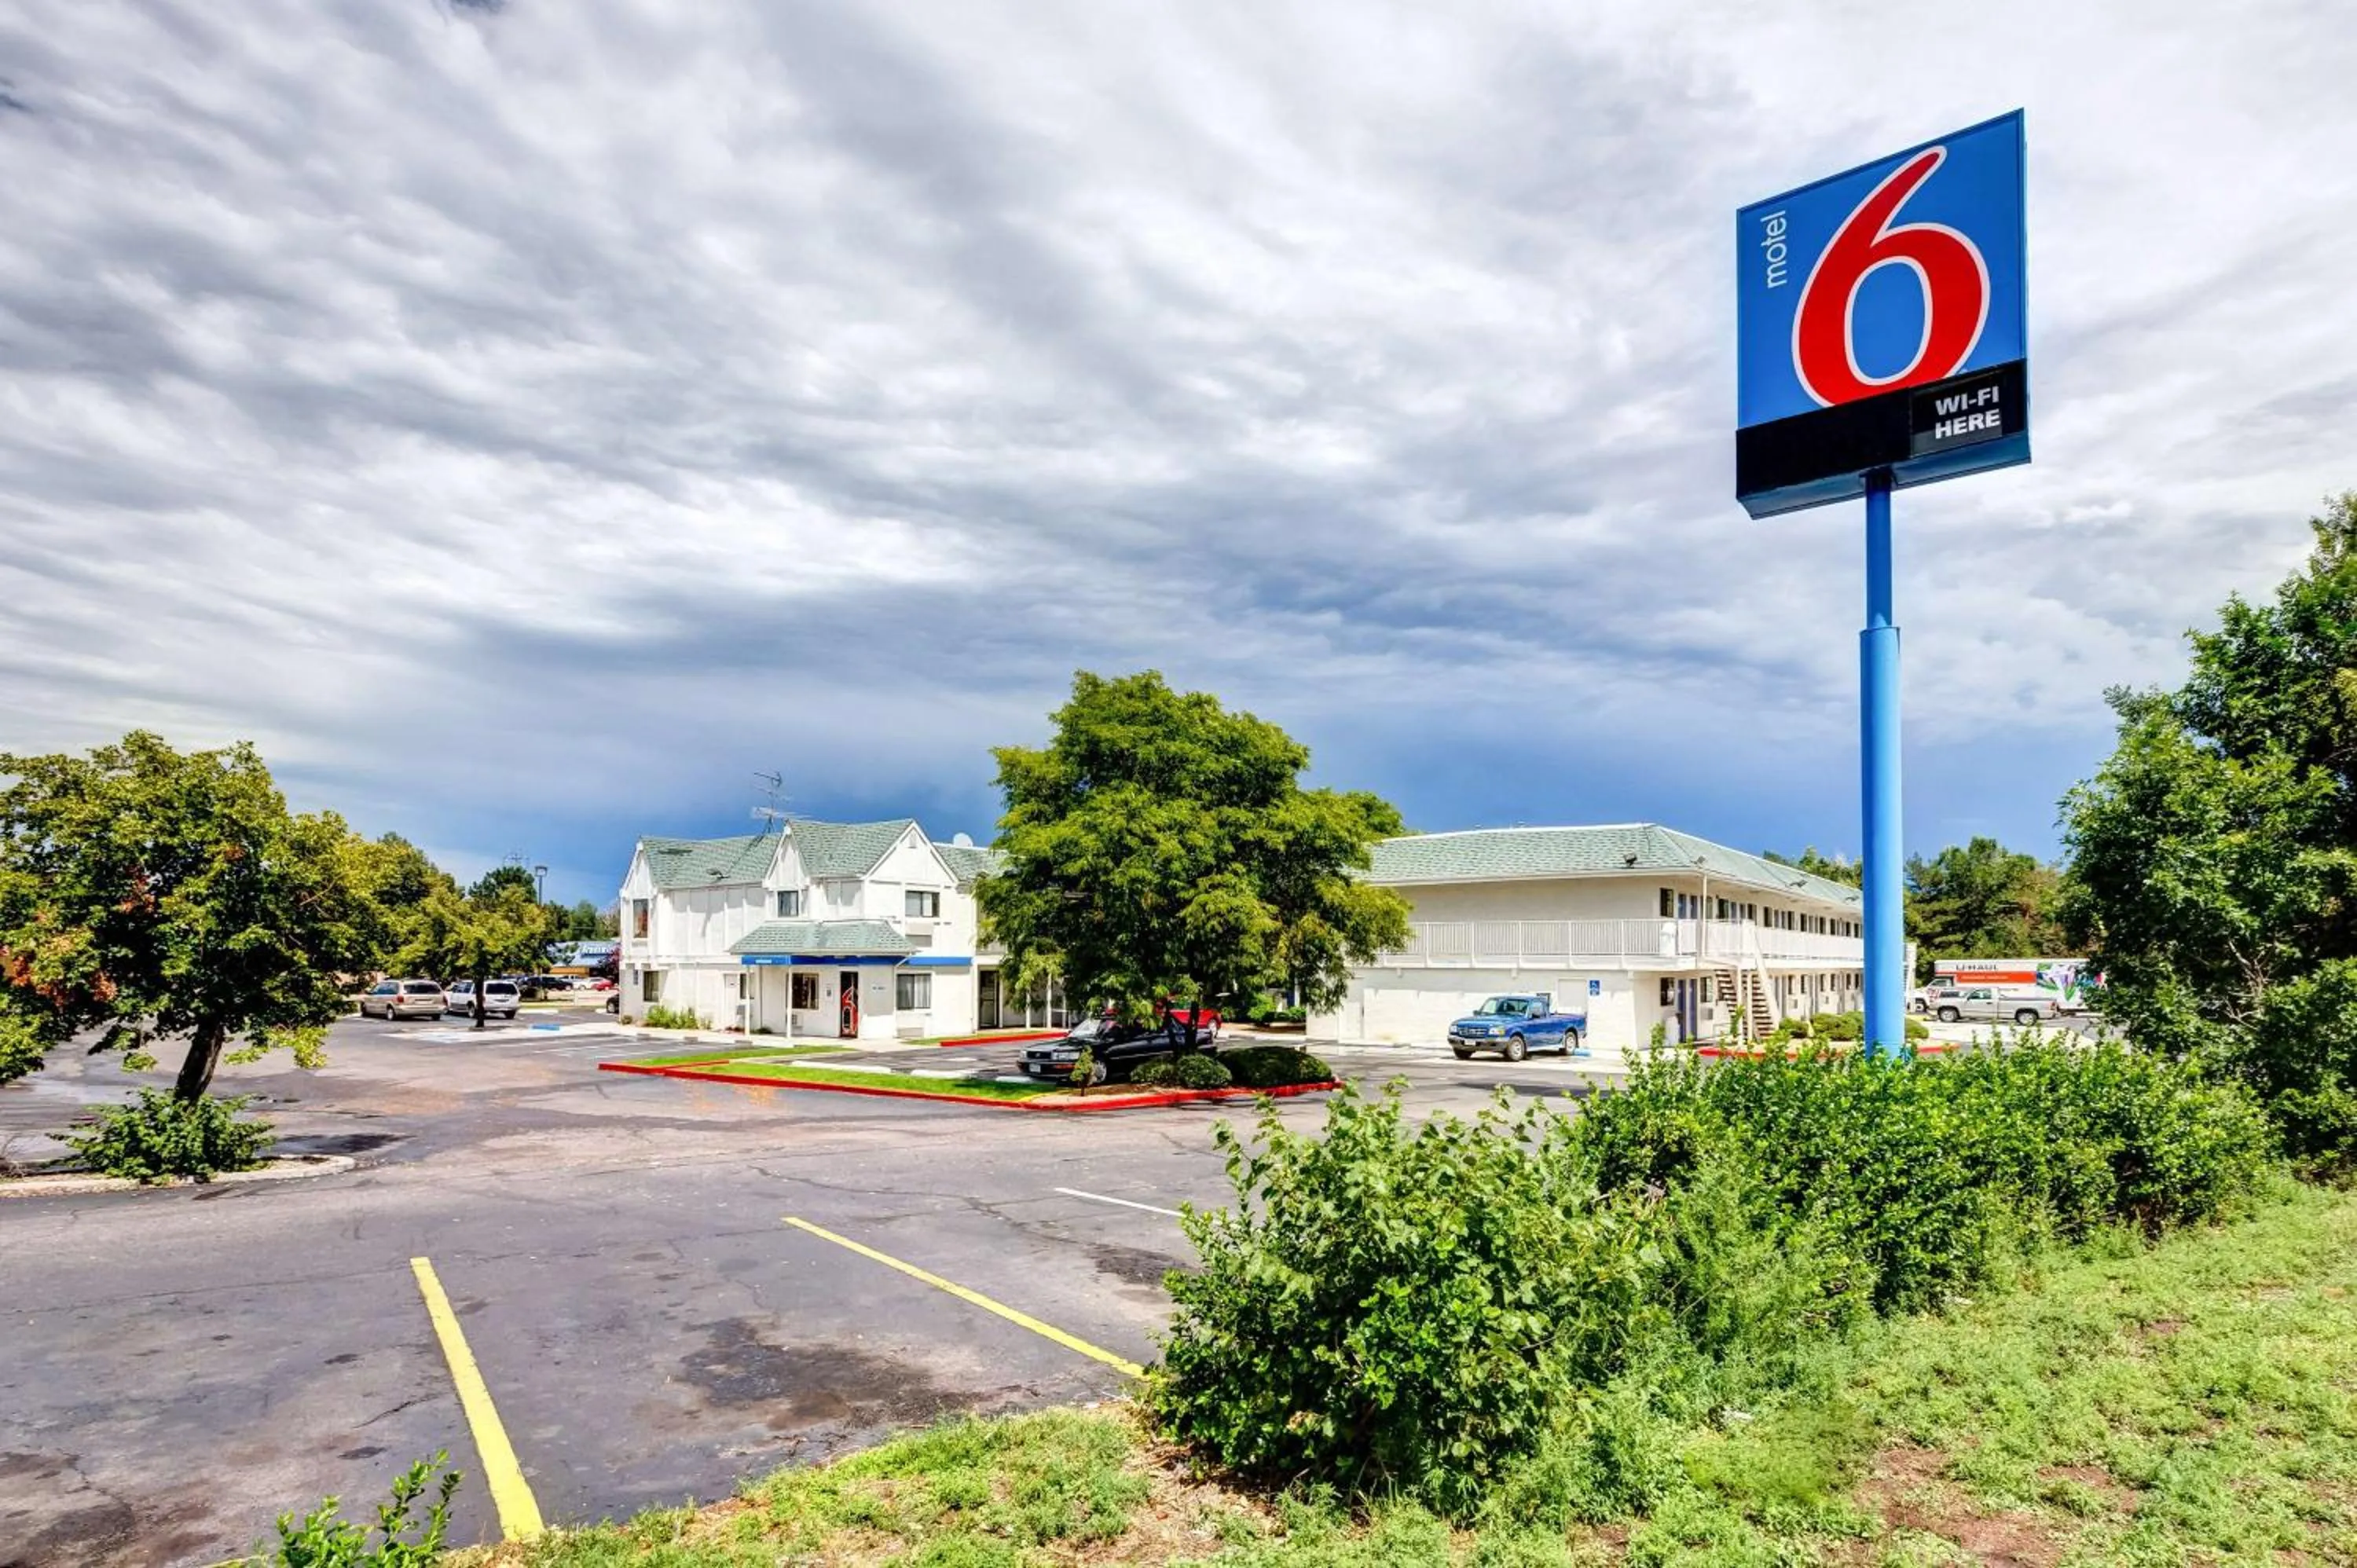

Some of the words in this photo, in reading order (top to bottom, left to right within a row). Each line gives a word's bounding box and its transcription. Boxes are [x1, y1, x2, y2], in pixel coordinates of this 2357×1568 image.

[1760, 209, 1787, 288] motel
[1791, 145, 1990, 407] 6
[1935, 386, 2000, 416] WI-FI
[1935, 408, 2001, 439] HERE
